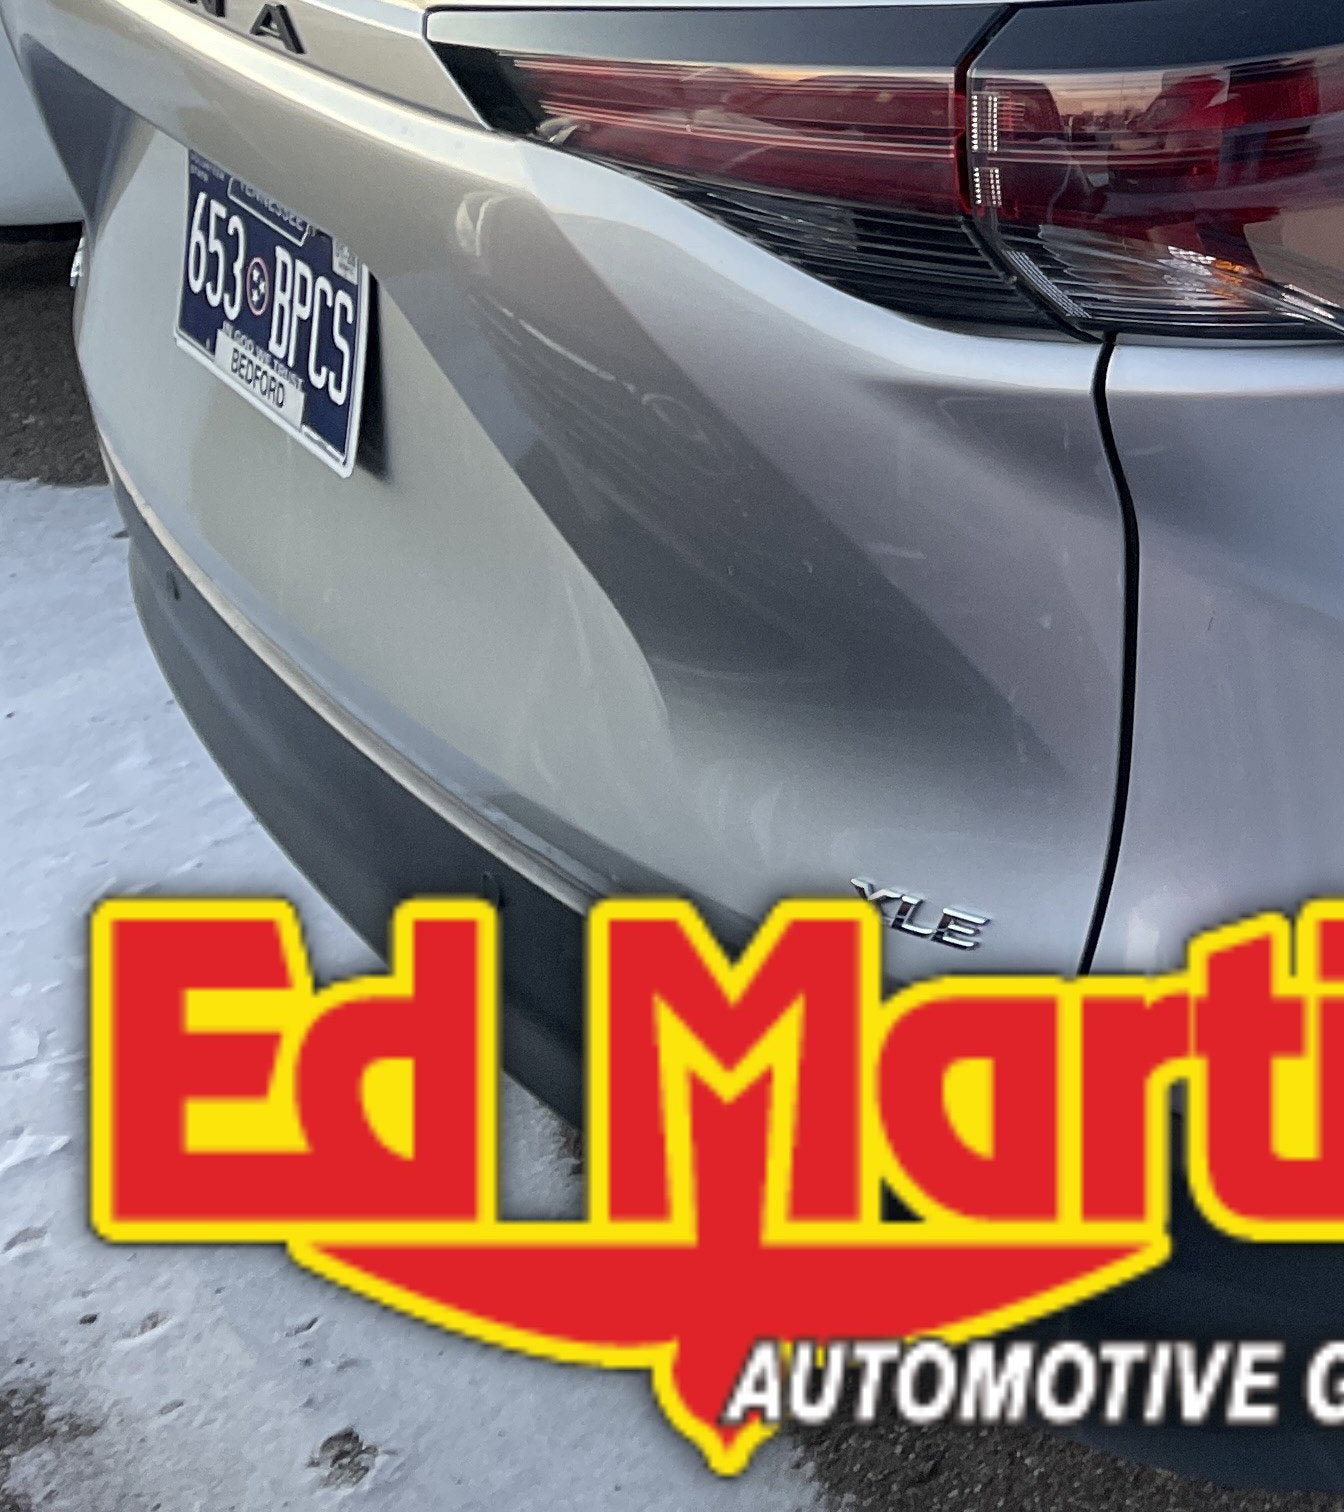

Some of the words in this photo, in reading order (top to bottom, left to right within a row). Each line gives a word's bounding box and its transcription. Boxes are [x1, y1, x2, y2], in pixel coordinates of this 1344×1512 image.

[187, 191, 246, 320] 653
[268, 245, 355, 406] BPCS
[231, 347, 286, 408] BEDFORD
